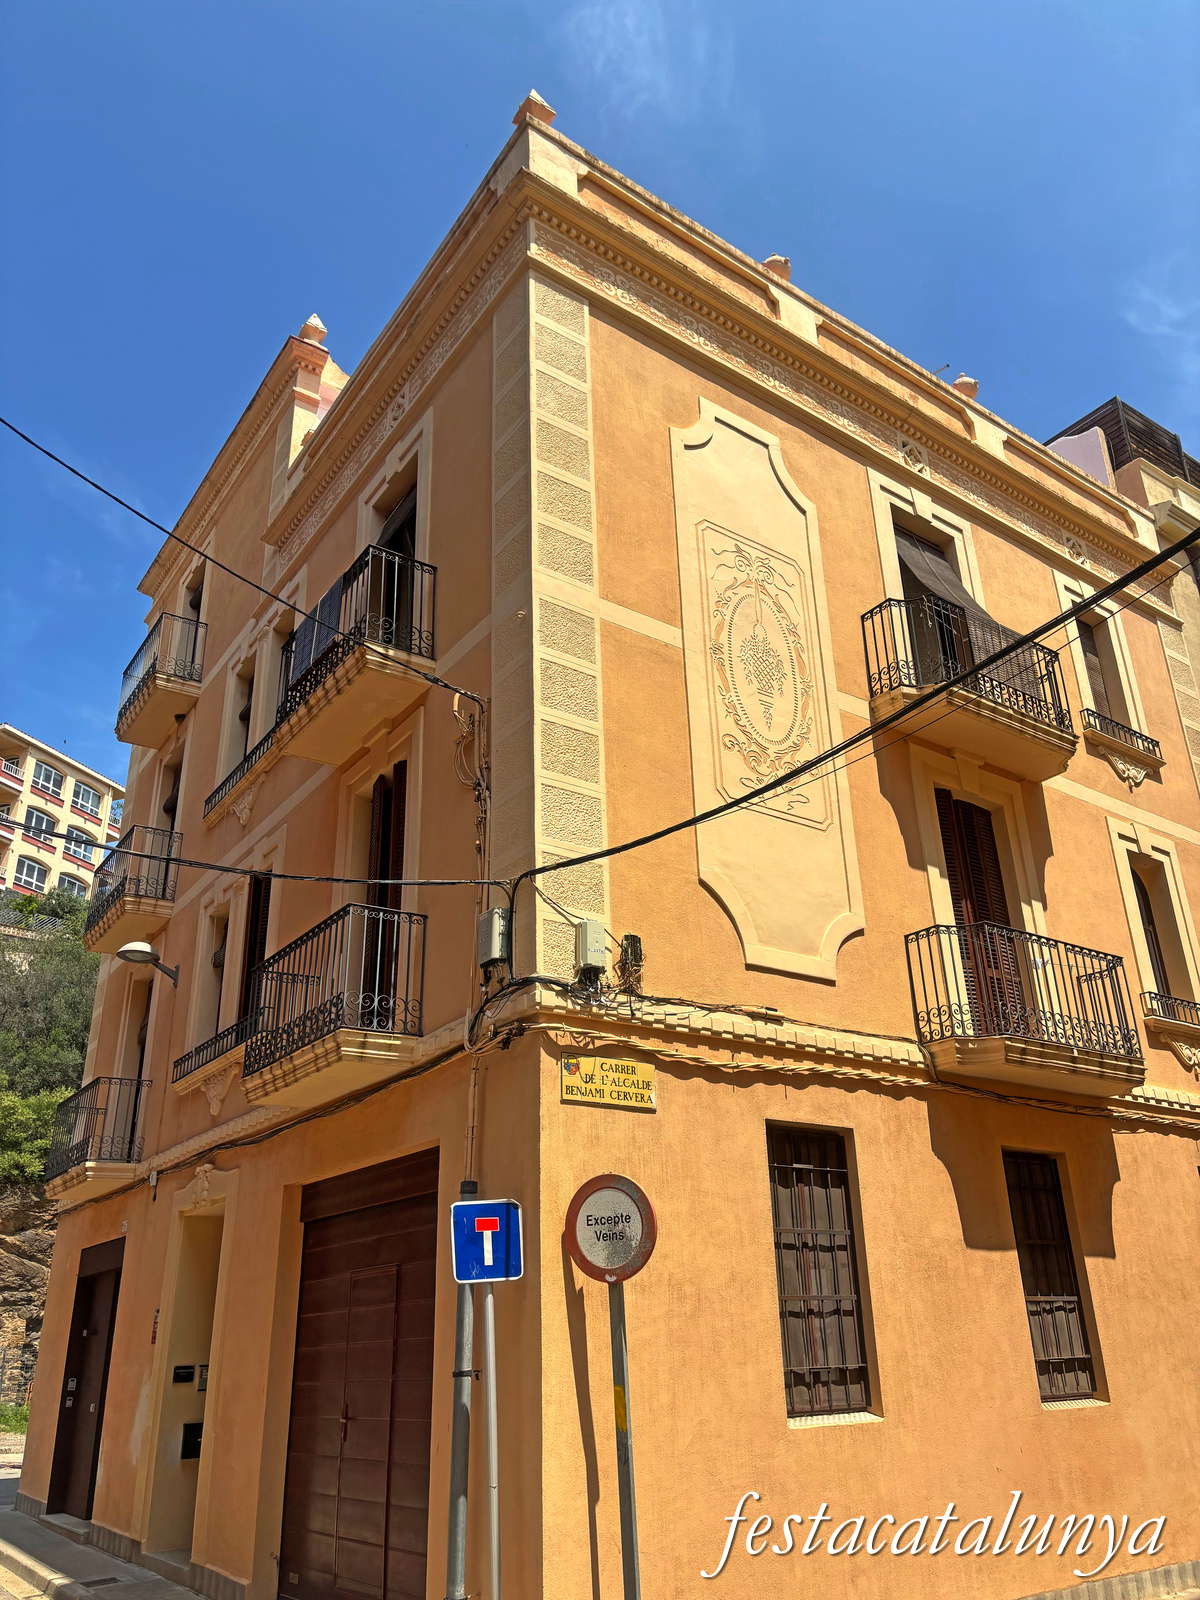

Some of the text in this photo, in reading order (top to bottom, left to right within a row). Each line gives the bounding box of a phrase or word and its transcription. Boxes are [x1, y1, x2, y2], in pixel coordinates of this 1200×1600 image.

[600, 1062, 637, 1076] CARRER
[584, 1073, 597, 1085] DE
[565, 1084, 654, 1104] BENJAMI CERVERA
[586, 1212, 632, 1227] Excepte
[594, 1229, 625, 1242] Veïns
